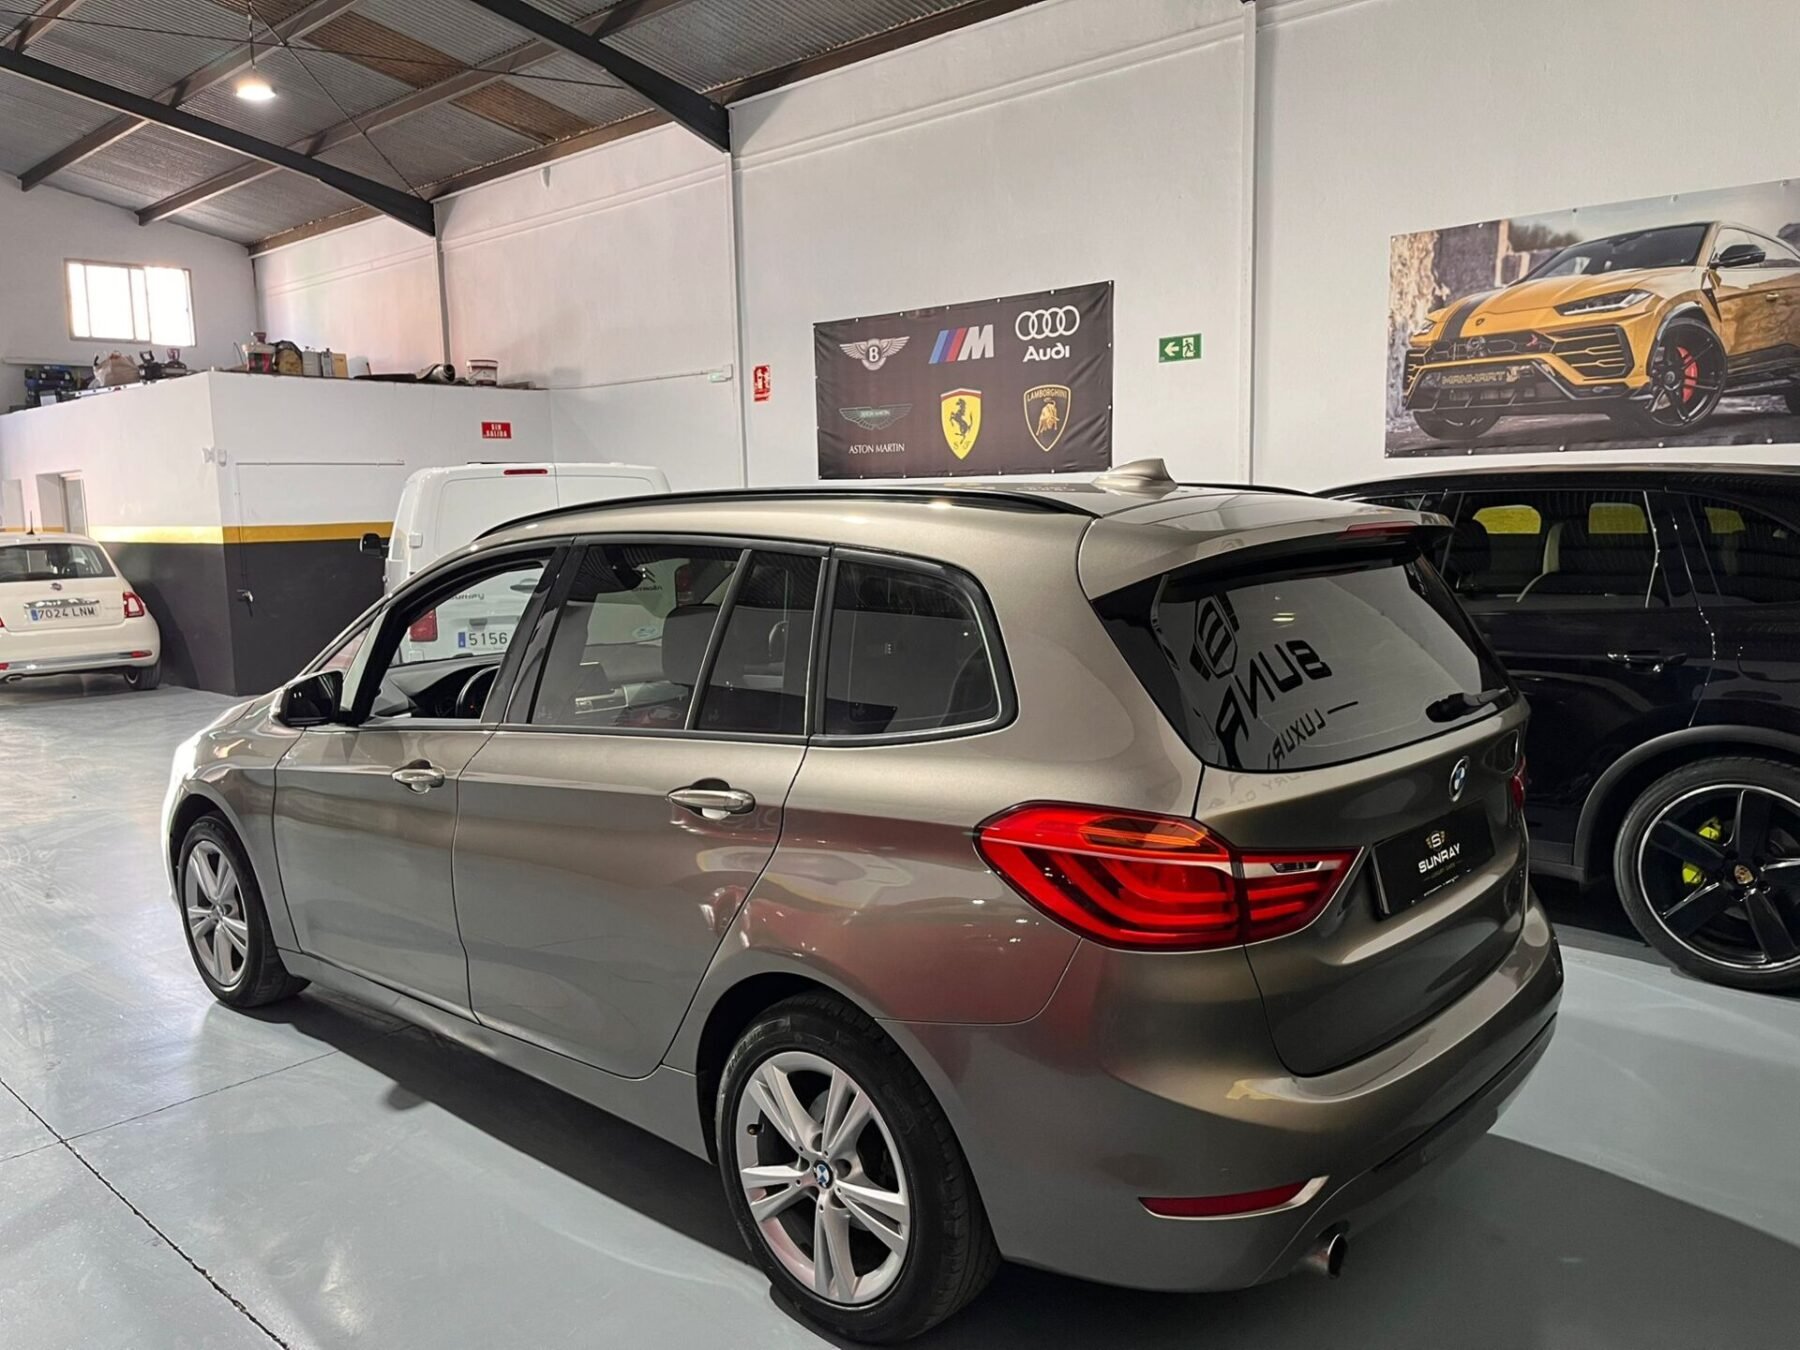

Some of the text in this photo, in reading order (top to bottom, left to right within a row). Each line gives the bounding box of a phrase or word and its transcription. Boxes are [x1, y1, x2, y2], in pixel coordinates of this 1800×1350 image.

[1022, 342, 1070, 362] Audi
[1027, 388, 1067, 402] LAMBORGHINI
[848, 443, 905, 455] ASTON MARTIN
[38, 606, 96, 619] 7024 LNM
[469, 632, 508, 646] 5156
[1418, 843, 1461, 874] SUNRAY
